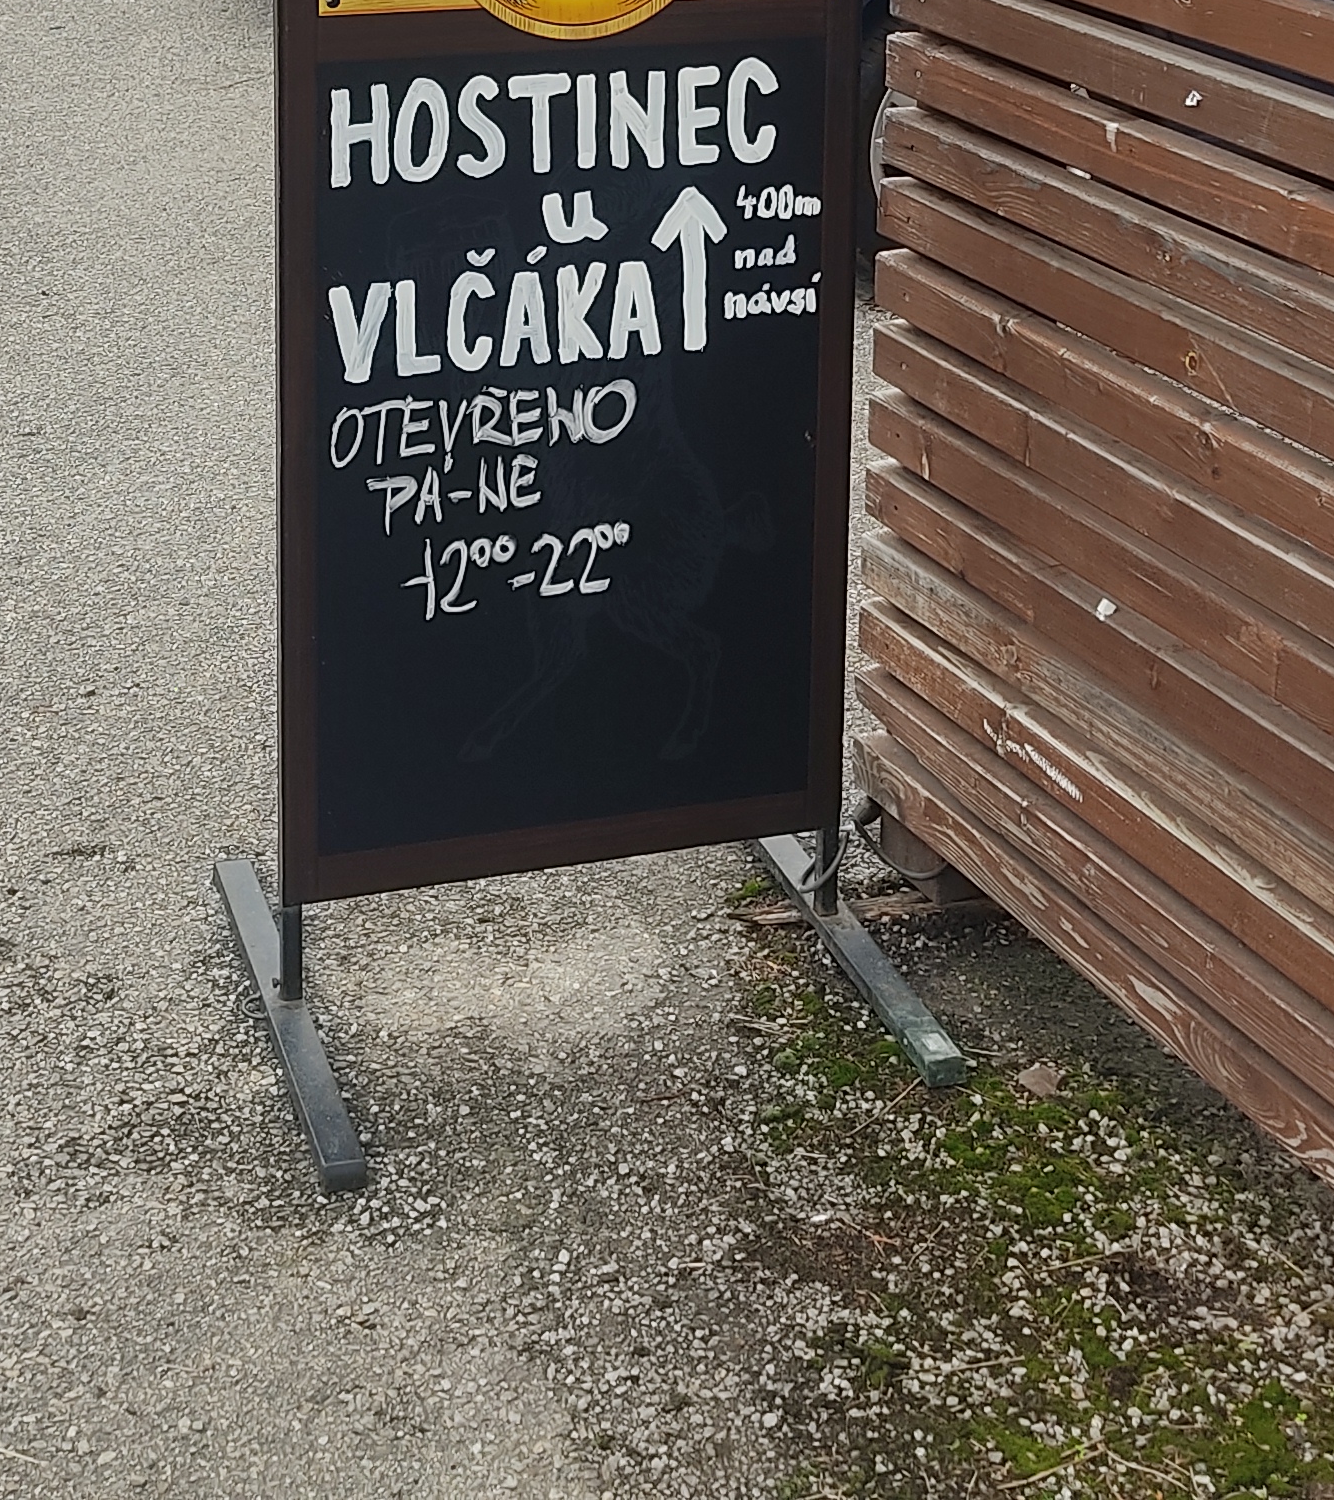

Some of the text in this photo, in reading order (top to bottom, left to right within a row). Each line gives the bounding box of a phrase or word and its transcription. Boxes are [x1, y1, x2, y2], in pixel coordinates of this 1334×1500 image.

[329, 56, 780, 189] HOSTINEC
[735, 183, 822, 221] 400m
[733, 233, 797, 270] nad
[327, 245, 663, 384] VLČÁKA
[723, 271, 822, 321] návsí
